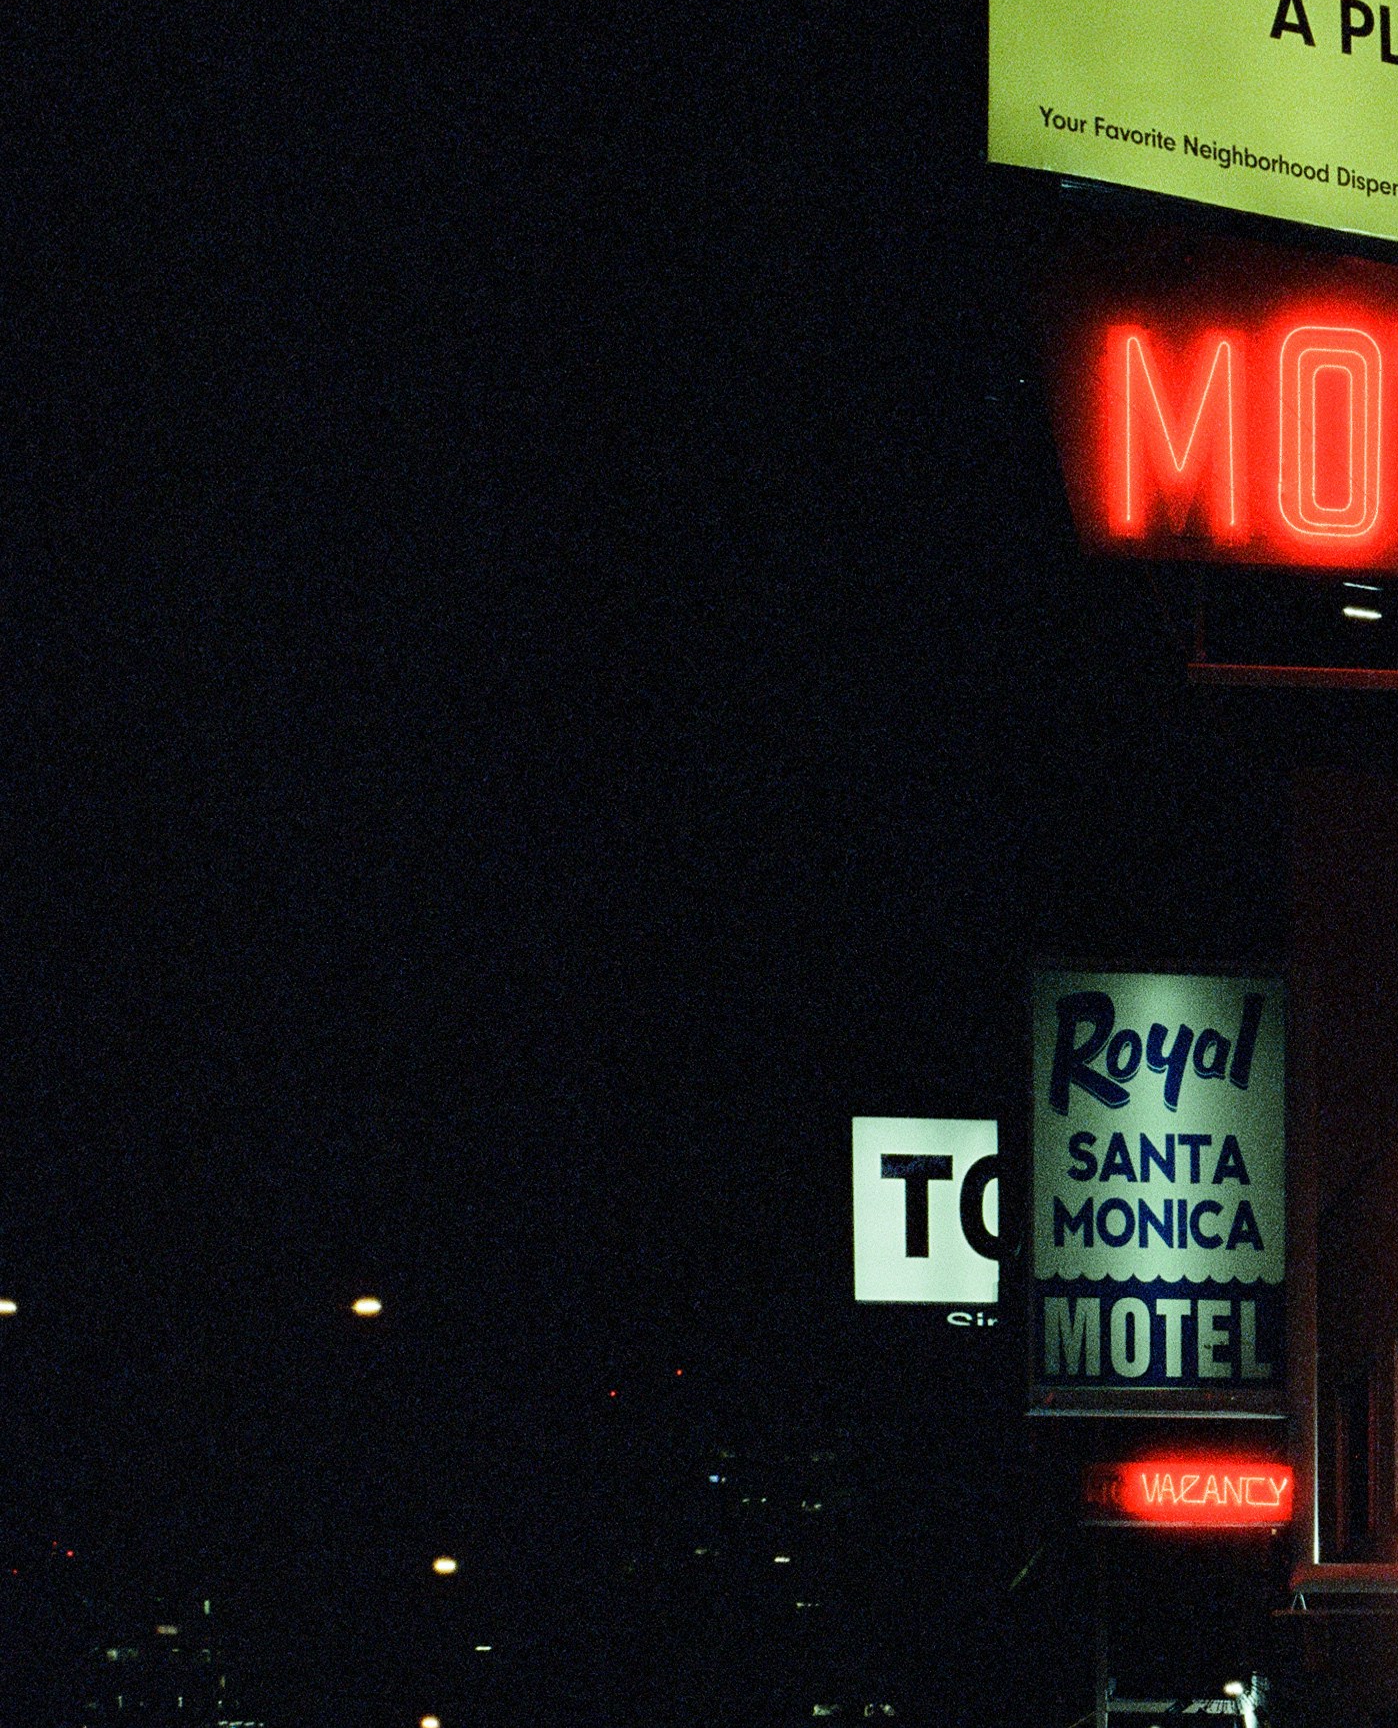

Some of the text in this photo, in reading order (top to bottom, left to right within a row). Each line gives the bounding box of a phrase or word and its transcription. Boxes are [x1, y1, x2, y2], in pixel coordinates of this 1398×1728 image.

[1039, 105, 1087, 134] Your
[1094, 116, 1177, 152] Favorite
[1183, 135, 1330, 183] Neighborhood
[1048, 991, 1265, 1116] Royal
[1067, 1131, 1250, 1185] SANTA
[1053, 1196, 1264, 1251] MONICA
[1045, 1296, 1271, 1379] MOTEL
[1141, 1472, 1289, 1507] VACANCY
